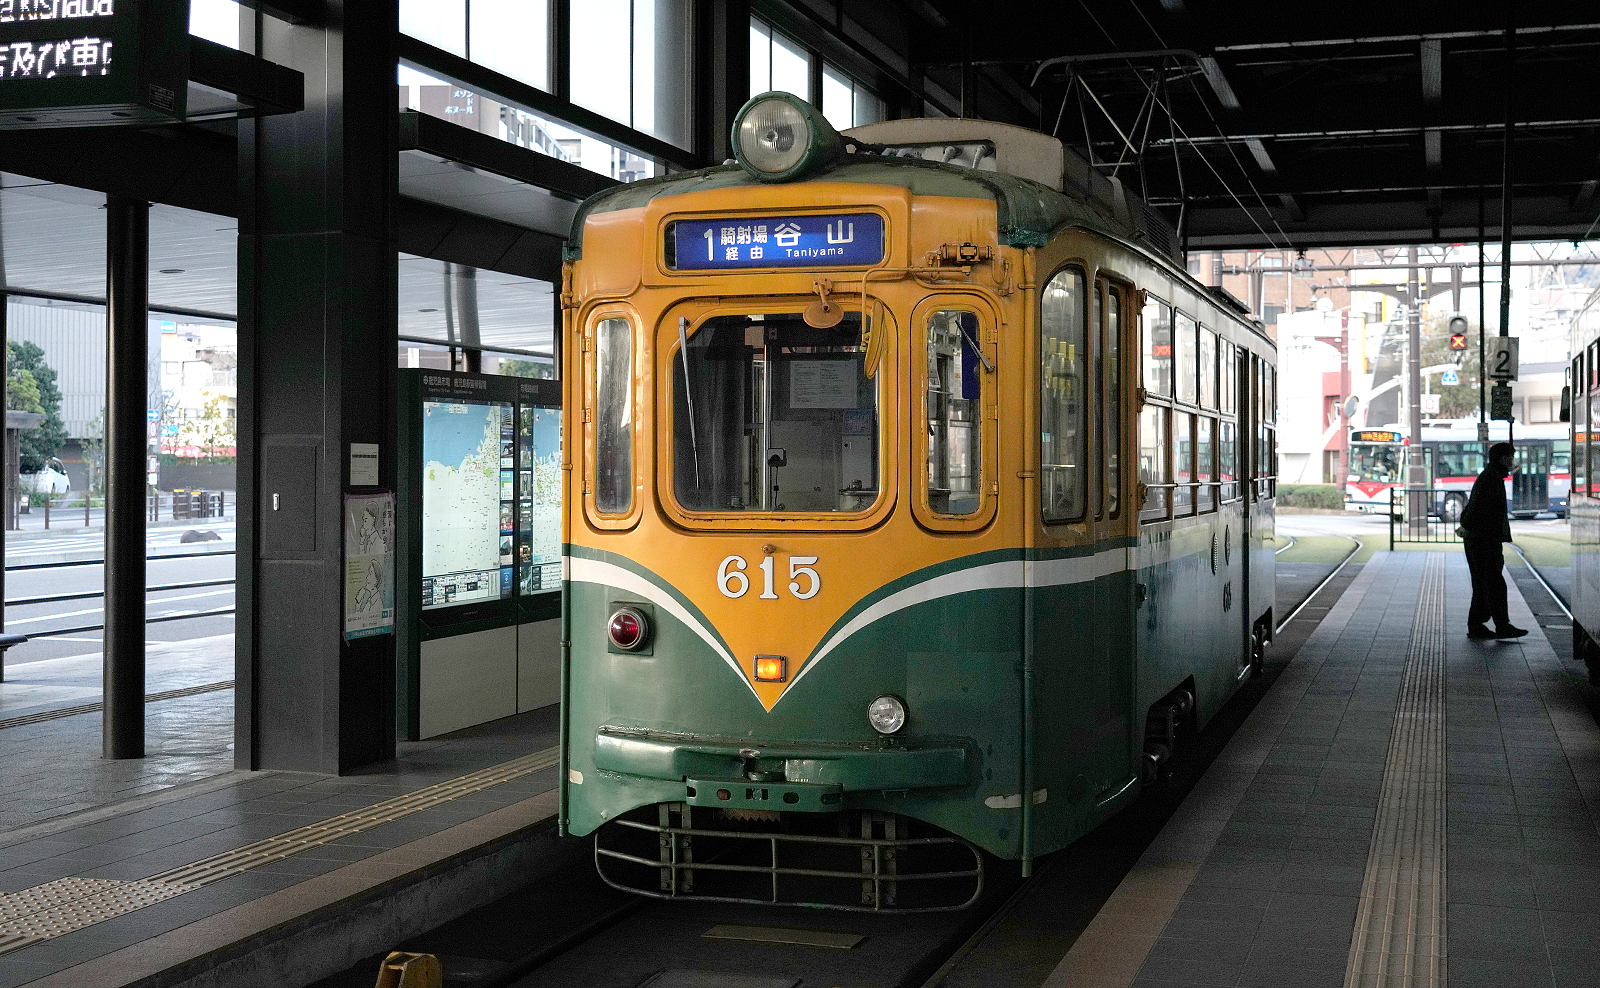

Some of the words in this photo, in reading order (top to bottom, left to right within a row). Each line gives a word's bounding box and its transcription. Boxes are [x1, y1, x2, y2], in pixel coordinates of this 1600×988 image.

[703, 228, 714, 262] 1
[720, 225, 768, 246] 騎射場
[785, 246, 844, 258] Taniyama
[1495, 350, 1510, 373] 2
[716, 555, 822, 600] 615
